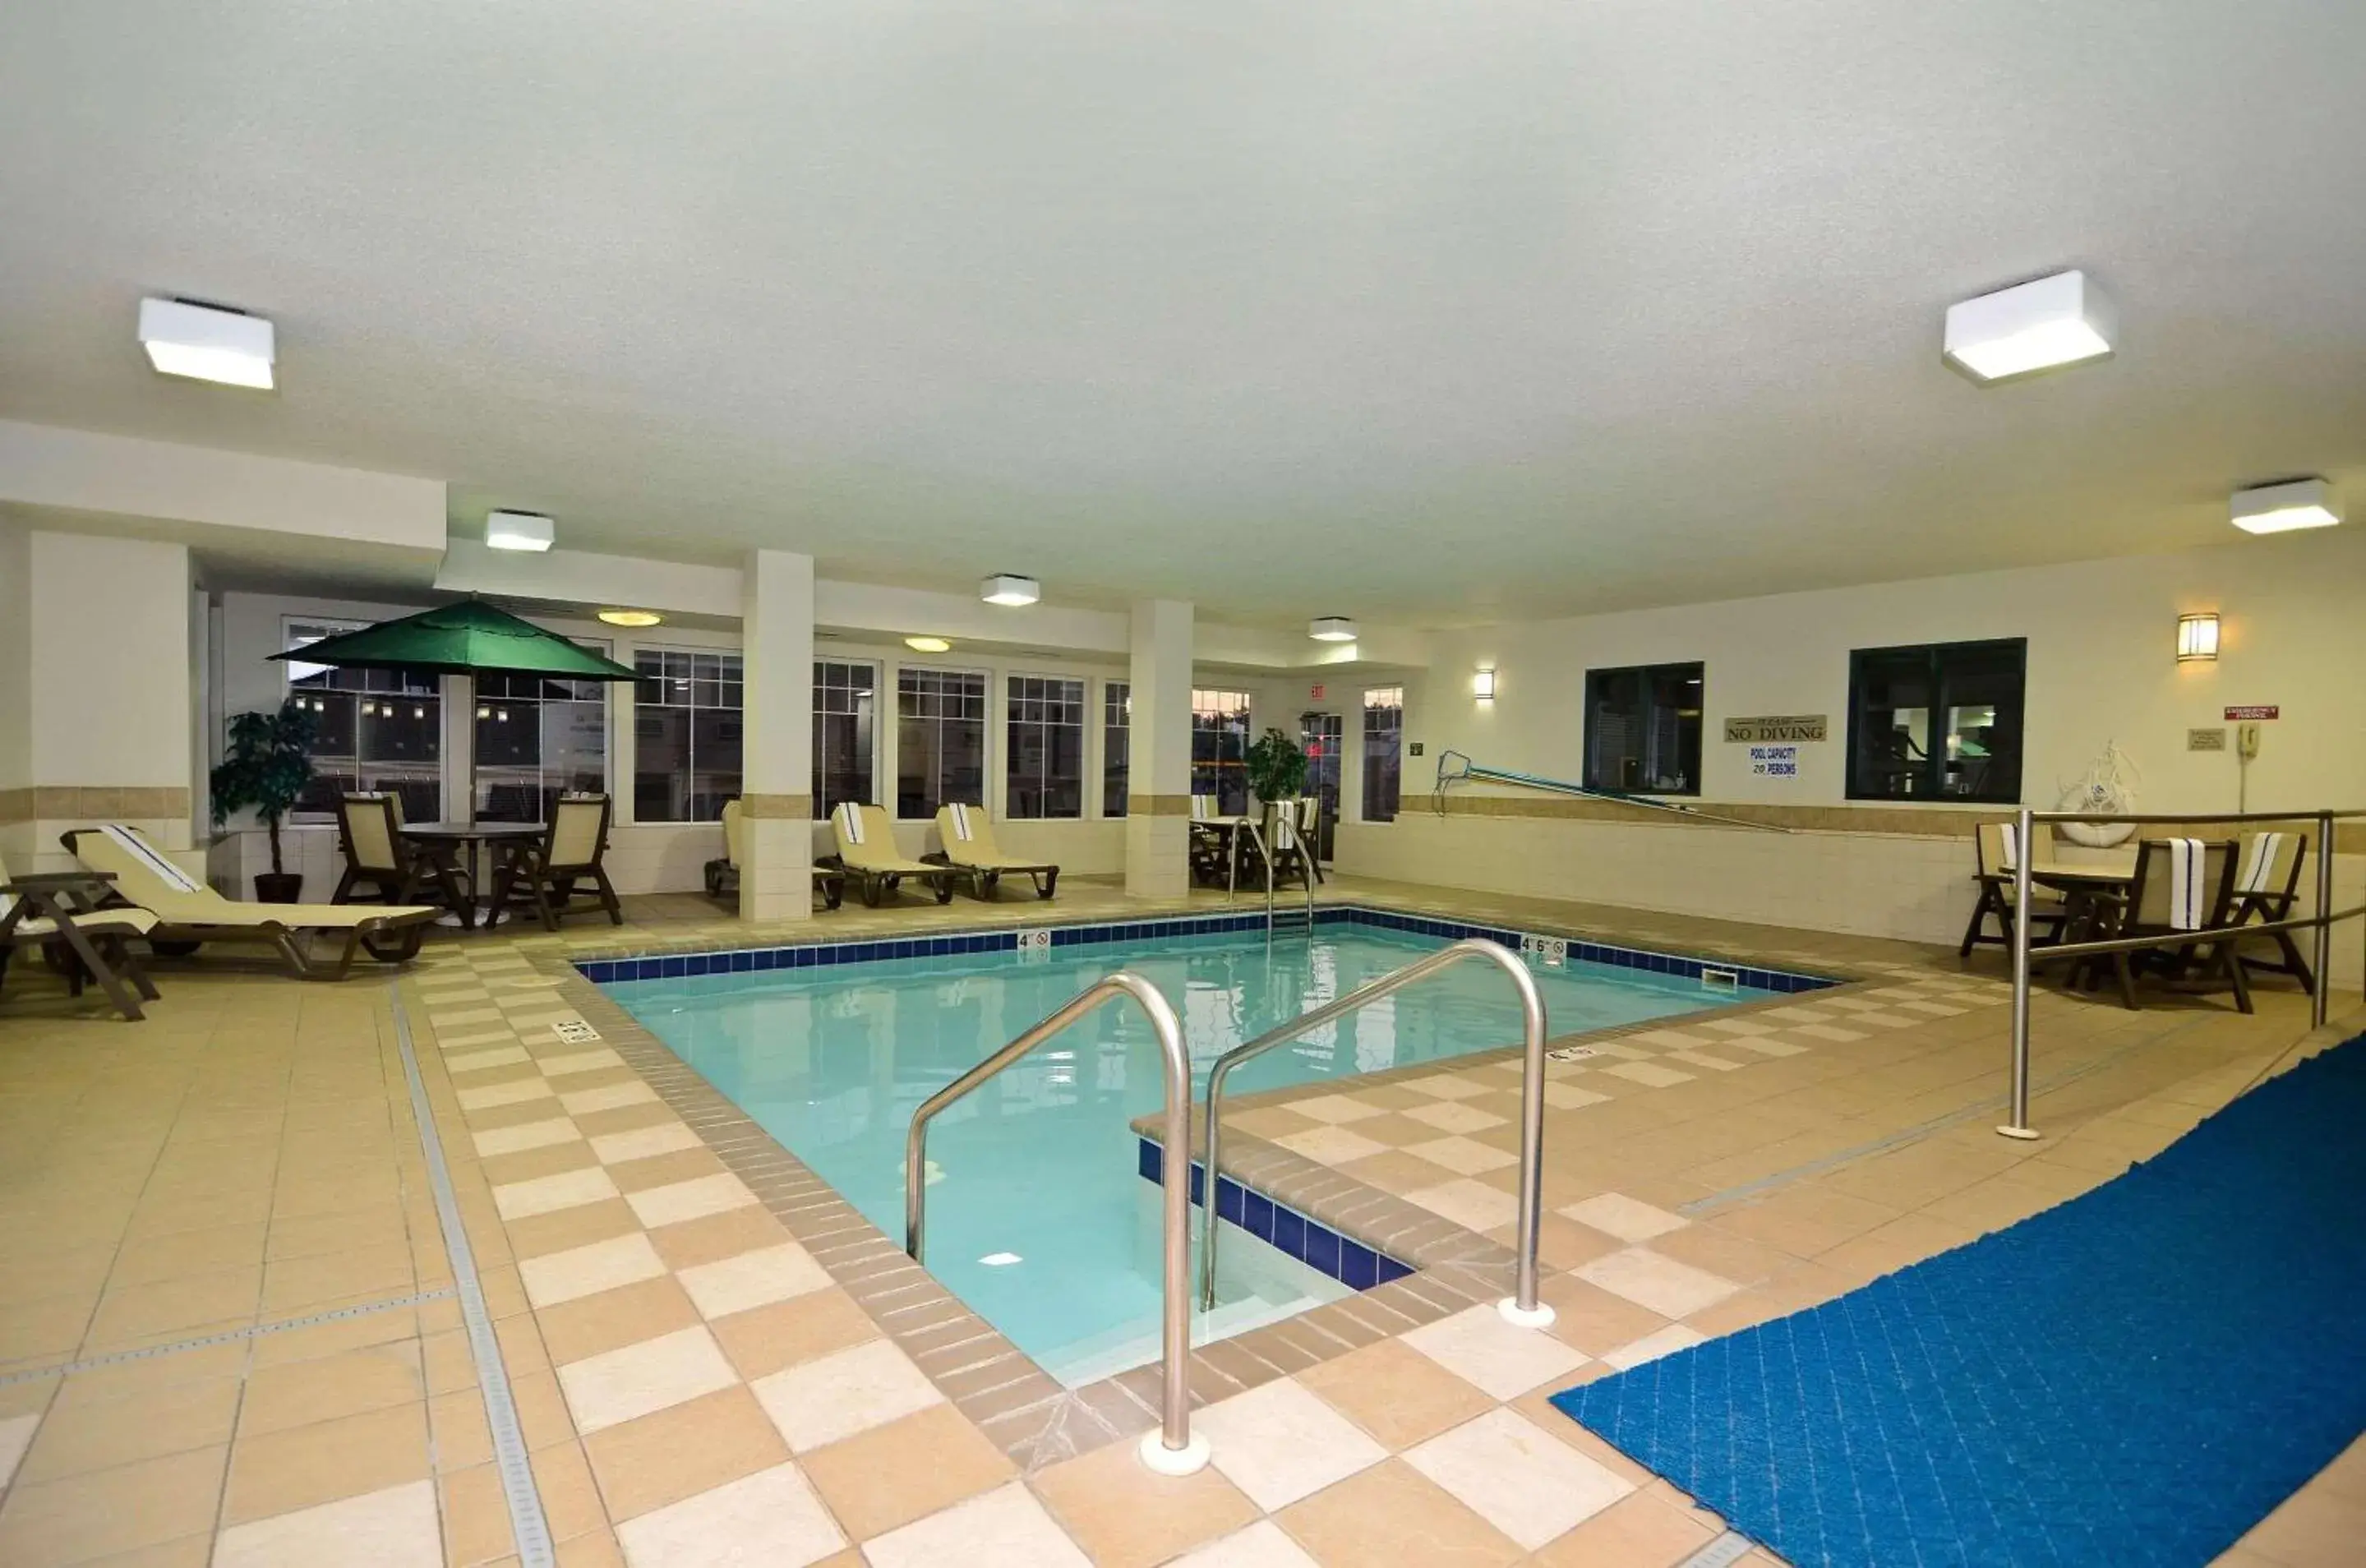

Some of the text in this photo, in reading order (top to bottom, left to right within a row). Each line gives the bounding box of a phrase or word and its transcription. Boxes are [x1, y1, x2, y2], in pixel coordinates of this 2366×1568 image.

[1728, 726, 1824, 740] NO DIVING
[1750, 748, 1766, 759] POOL
[1537, 940, 1544, 952] 6
